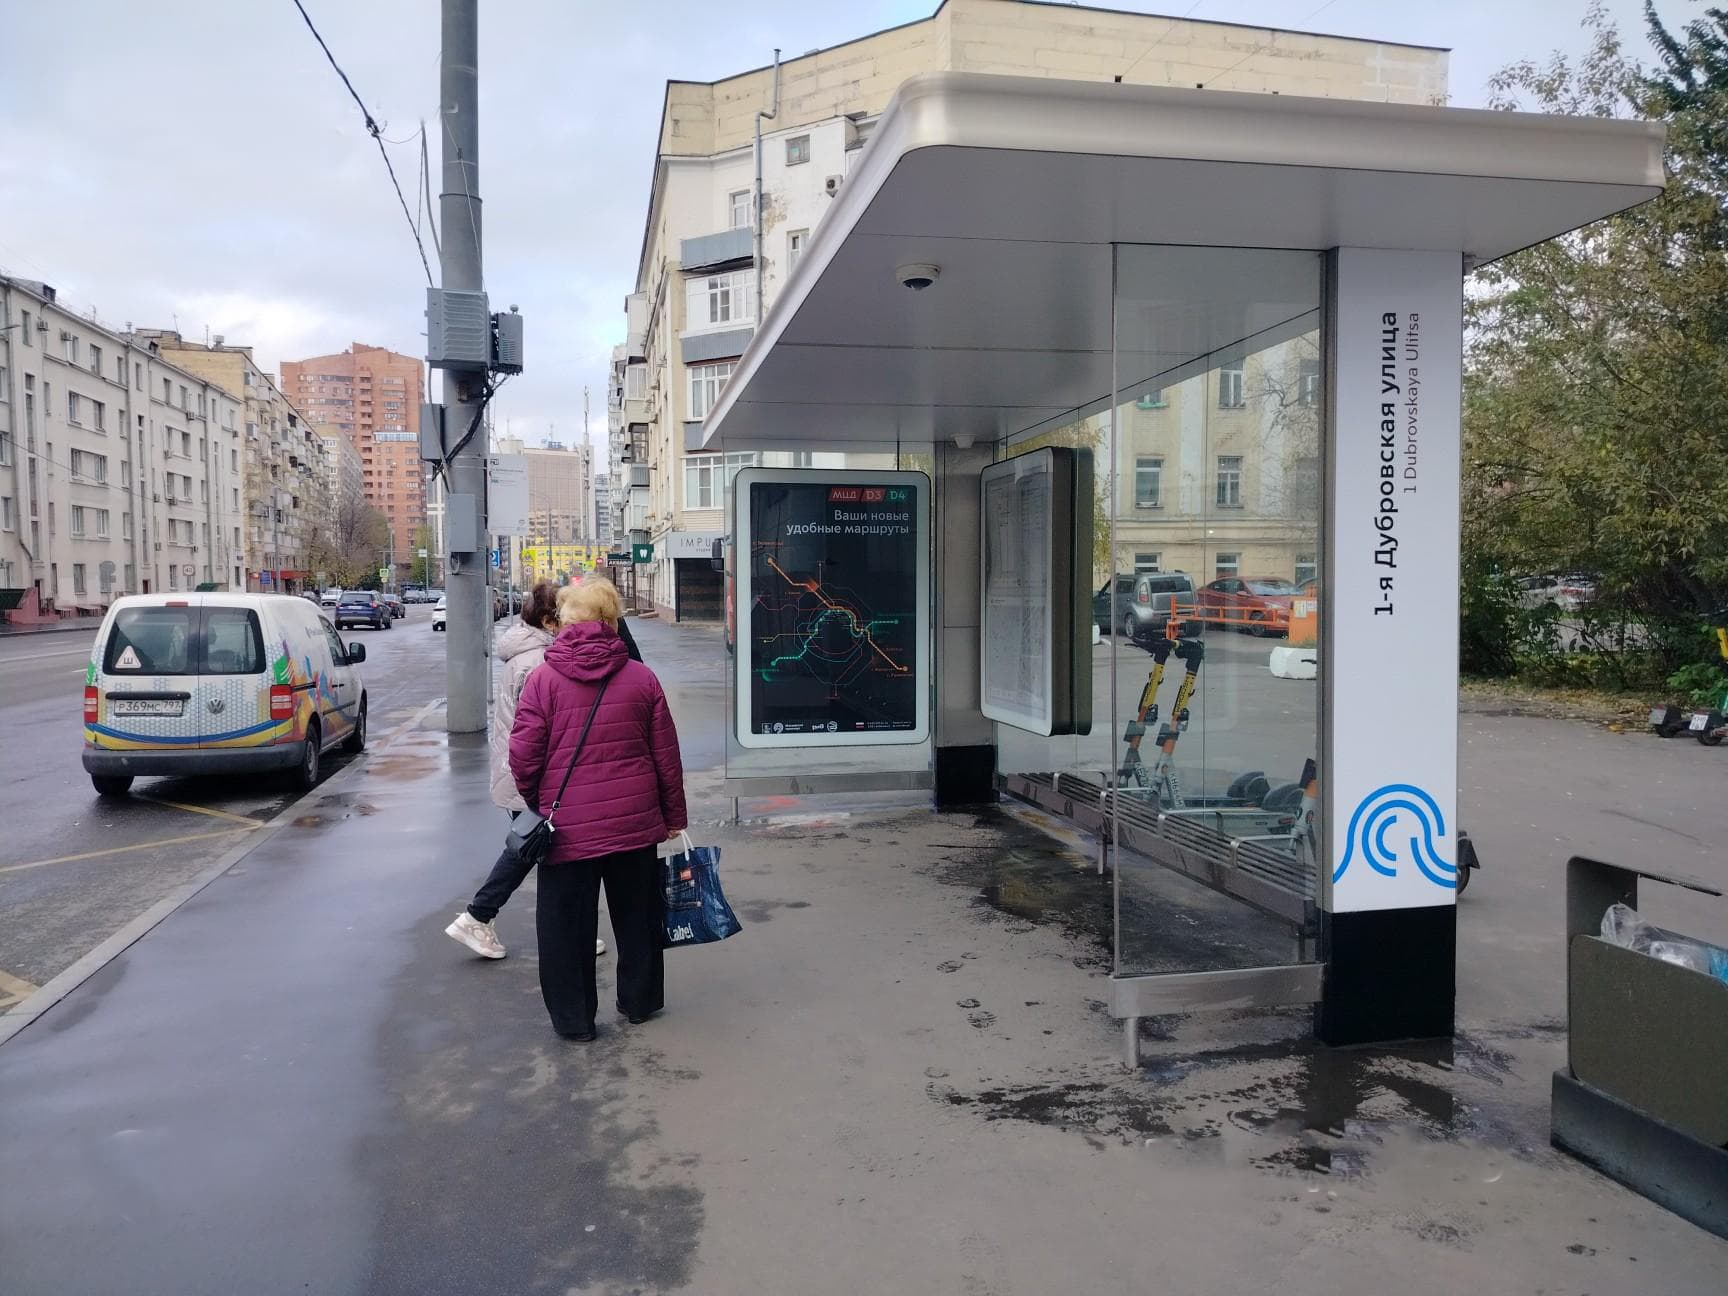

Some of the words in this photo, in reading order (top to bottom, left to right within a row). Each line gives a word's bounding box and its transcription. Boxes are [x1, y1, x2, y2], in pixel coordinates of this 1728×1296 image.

[1404, 312, 1419, 360] Ulitsa
[1380, 311, 1400, 394] улица
[1403, 367, 1421, 479] Dubrovskaya
[832, 490, 857, 500] МЦД
[866, 490, 882, 499] D3
[890, 490, 906, 500] D4
[1374, 402, 1399, 568] Дубровская
[785, 523, 842, 536] удобные
[844, 525, 909, 536] маршруты
[834, 509, 868, 521] Ваши
[871, 511, 909, 521] новые
[1374, 576, 1394, 616] 1-я
[123, 657, 133, 665] Ш
[667, 923, 694, 941] Label
